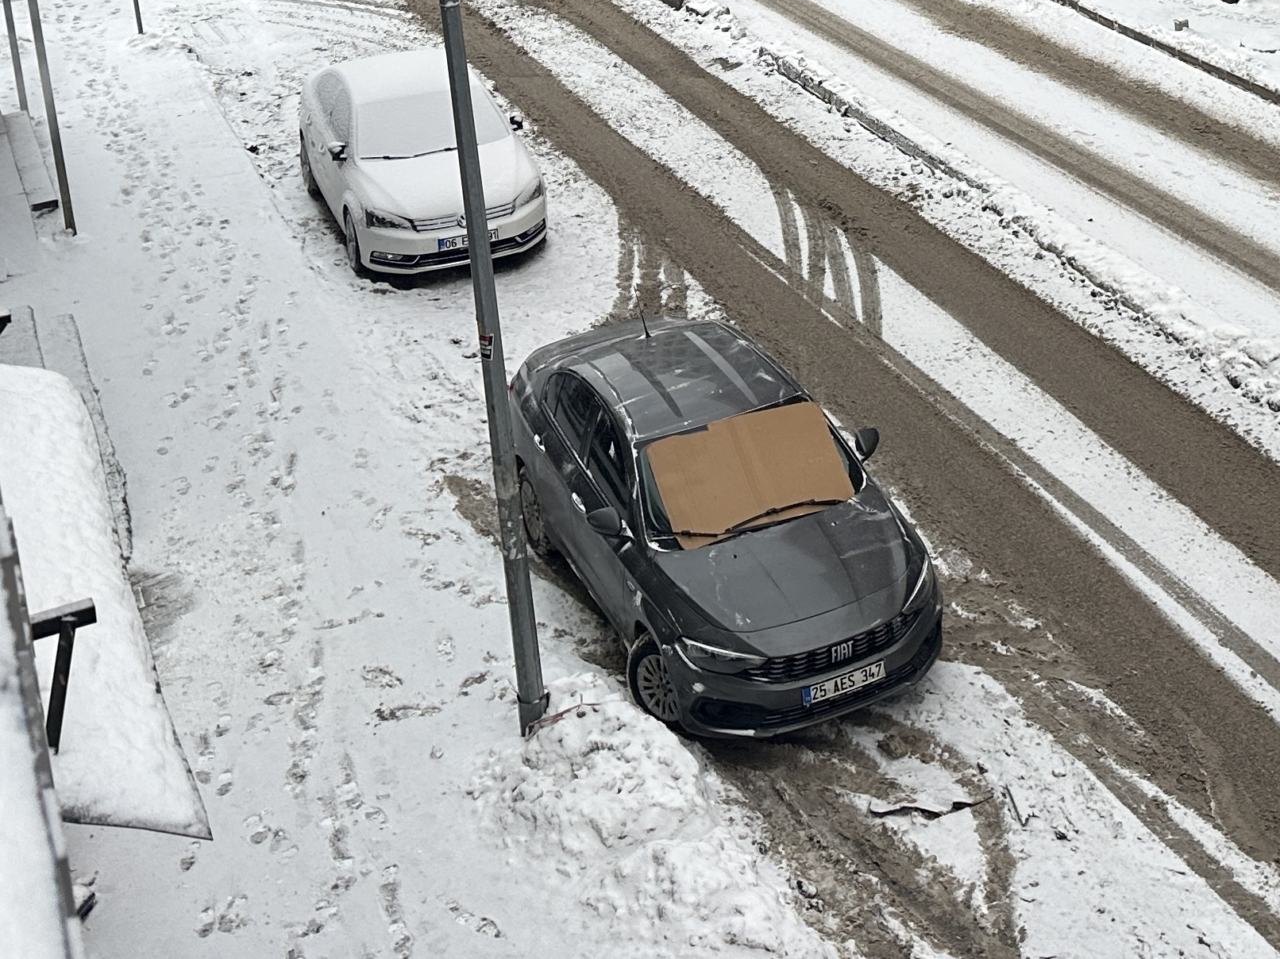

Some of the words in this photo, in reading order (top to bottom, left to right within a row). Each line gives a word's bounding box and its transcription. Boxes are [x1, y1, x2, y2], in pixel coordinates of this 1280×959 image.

[445, 239, 458, 249] 06
[831, 640, 854, 663] FIAT
[812, 684, 827, 701] 25
[833, 674, 856, 694] AES
[861, 663, 882, 682] 347
